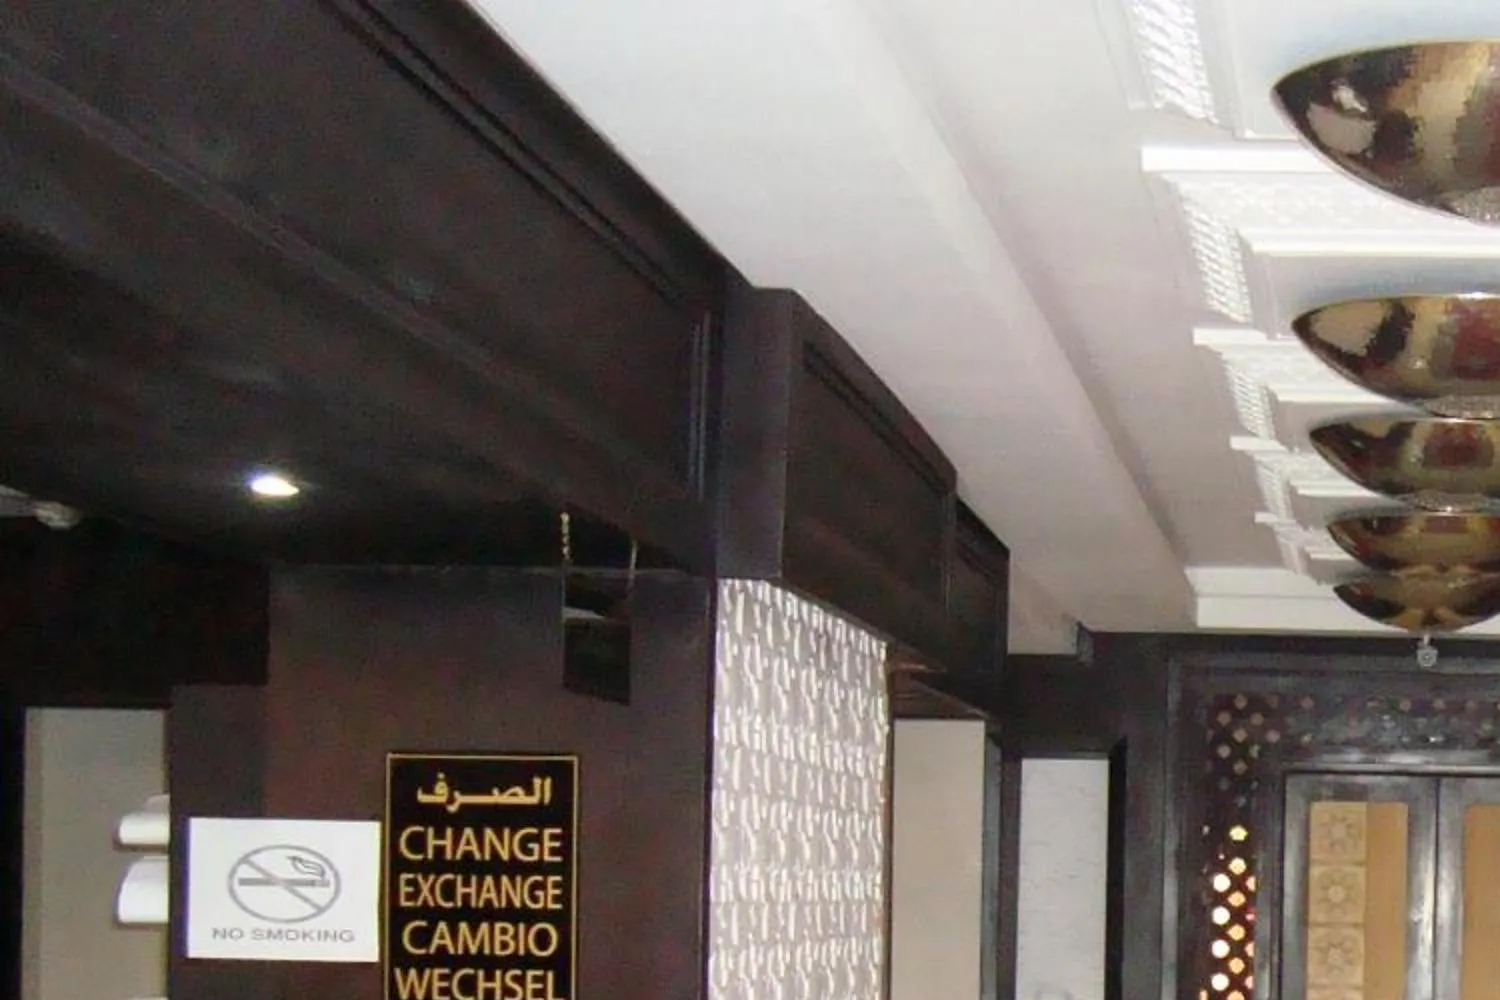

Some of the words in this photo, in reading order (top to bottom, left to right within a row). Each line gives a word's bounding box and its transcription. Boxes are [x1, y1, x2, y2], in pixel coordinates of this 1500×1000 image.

[417, 773, 552, 813] الصرف
[399, 826, 563, 862] CHANGE
[399, 873, 563, 909] EXCHANGE
[211, 927, 244, 941] NO
[251, 928, 356, 943] SMOKING
[402, 921, 558, 957] CAMBIO
